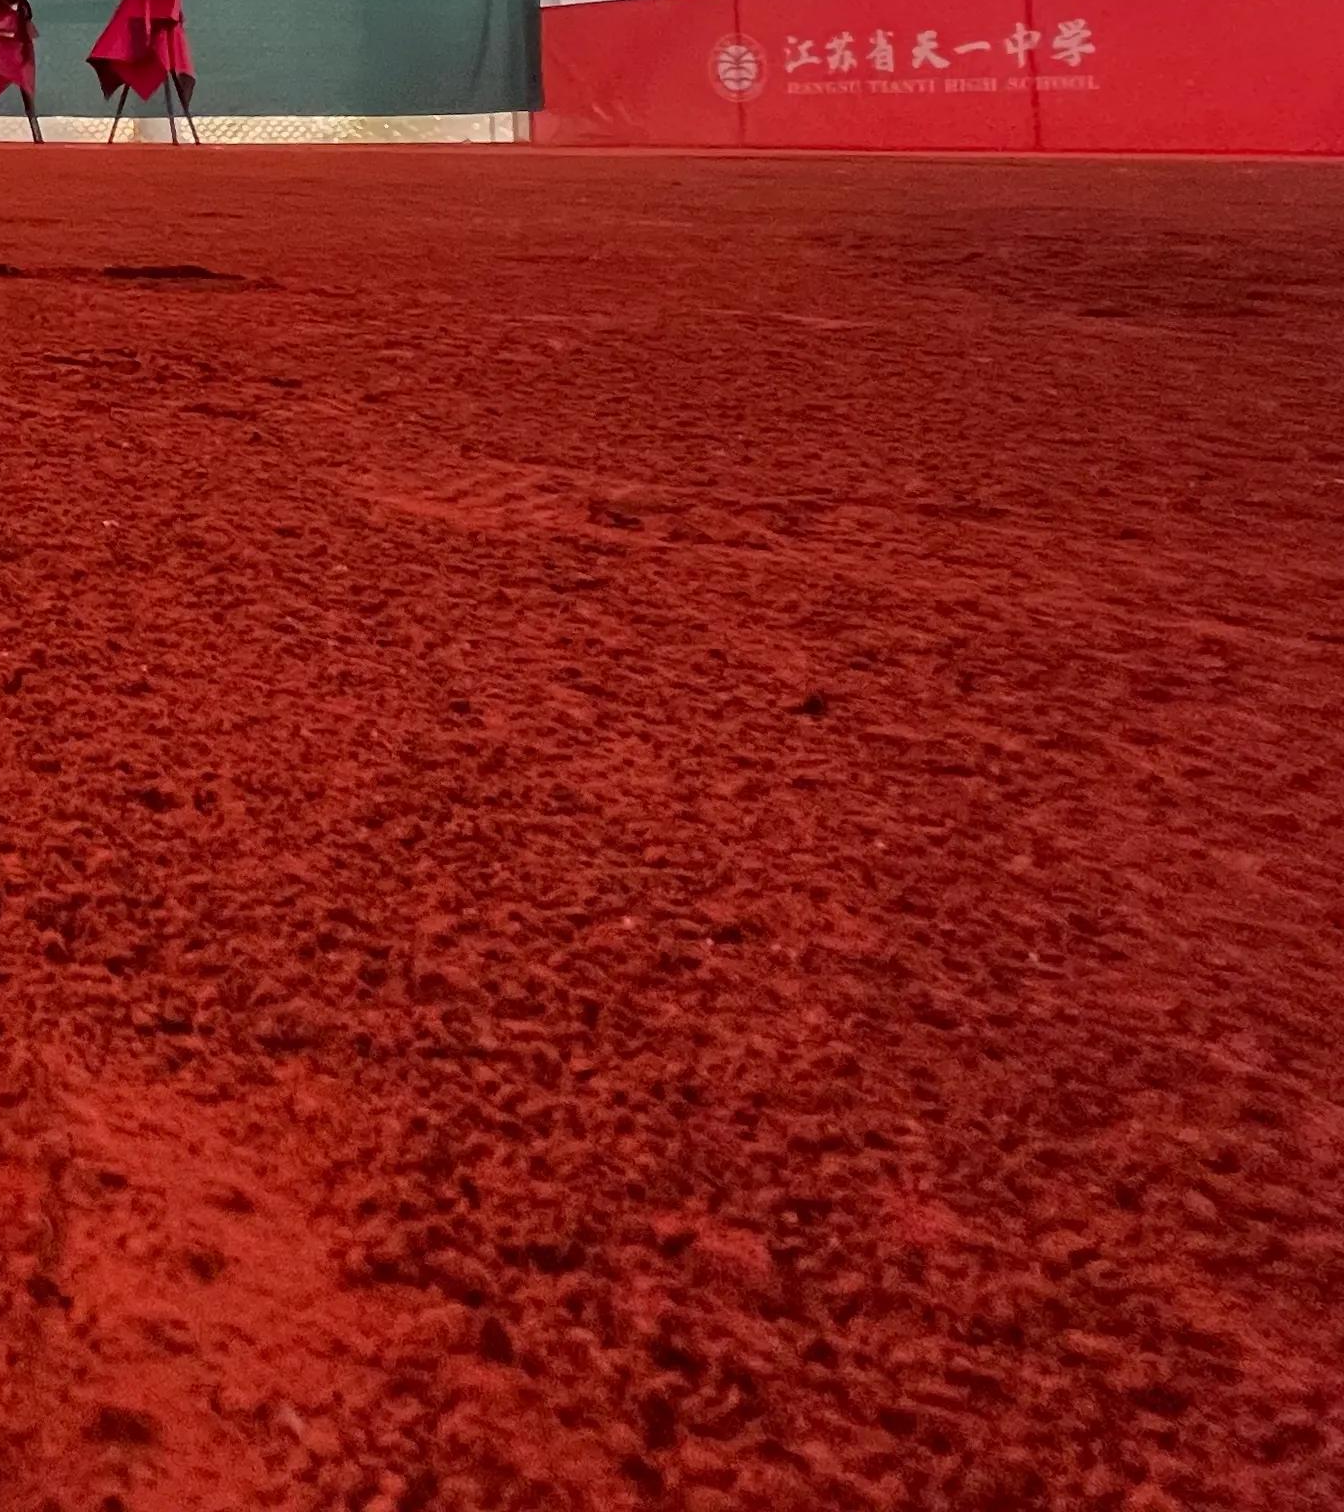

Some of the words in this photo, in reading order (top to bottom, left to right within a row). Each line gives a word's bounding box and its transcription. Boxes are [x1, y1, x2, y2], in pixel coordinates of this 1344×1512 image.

[783, 18, 1096, 74] 江苏省天一中学
